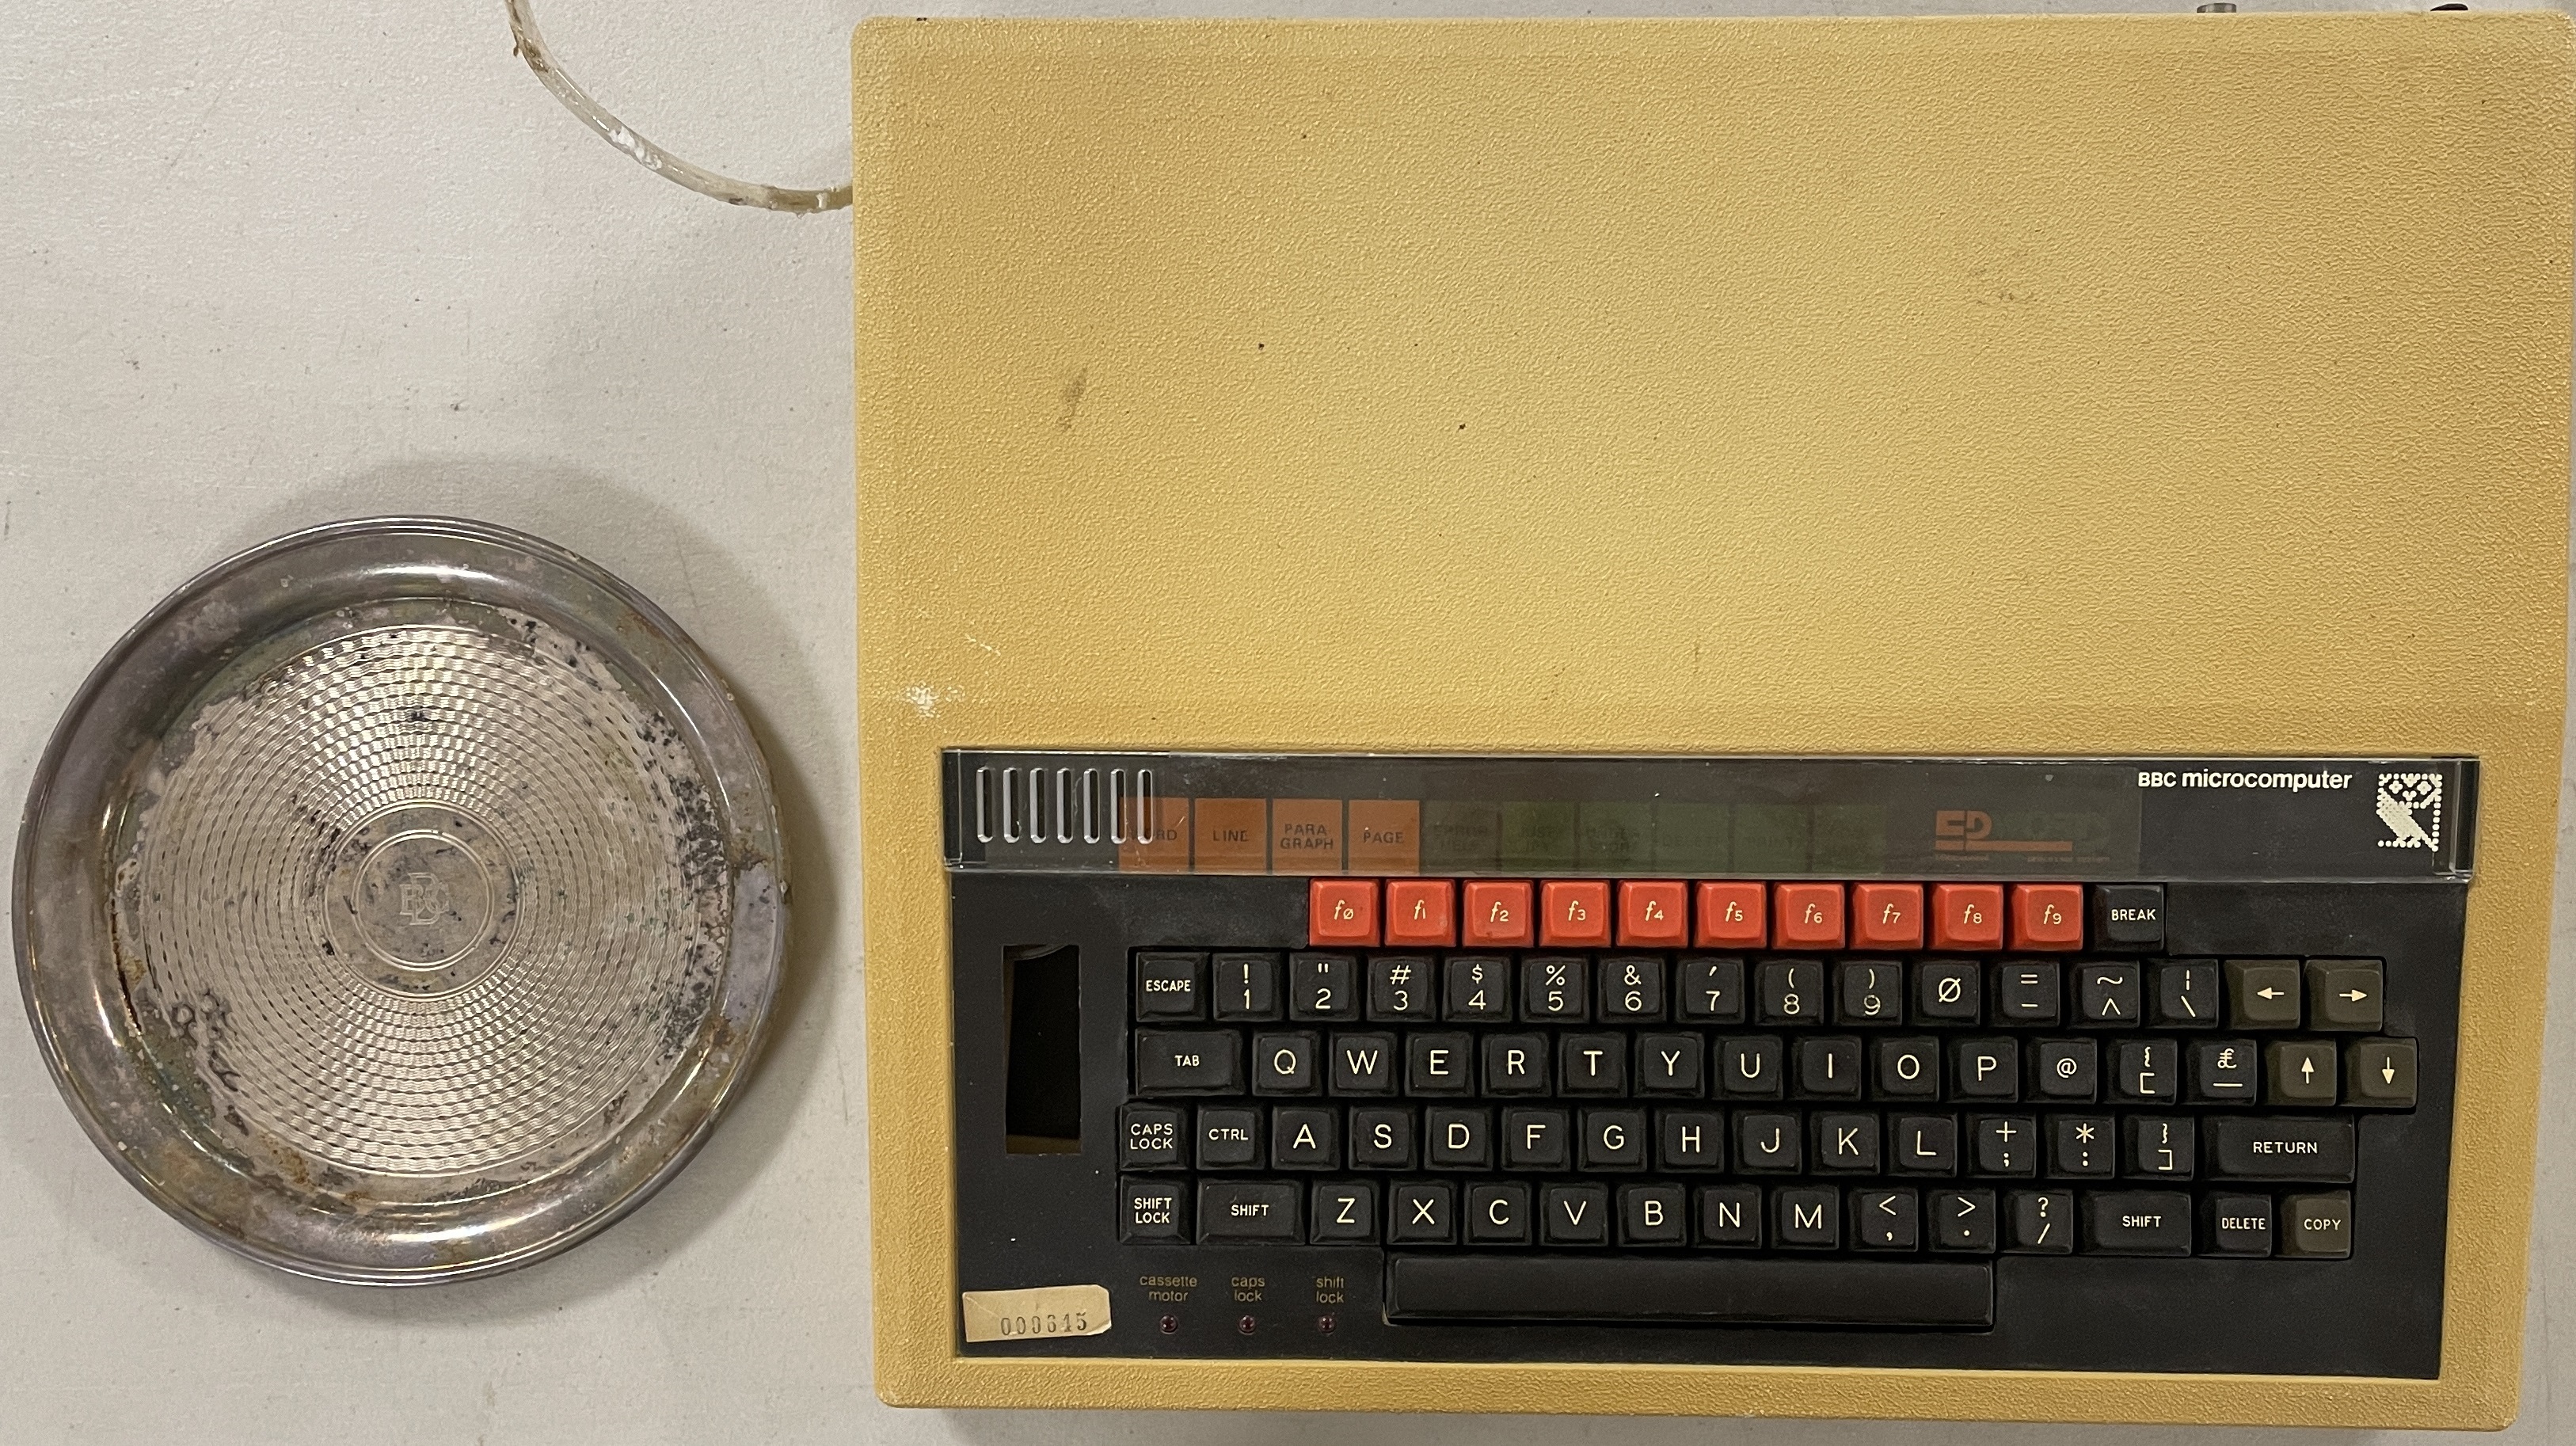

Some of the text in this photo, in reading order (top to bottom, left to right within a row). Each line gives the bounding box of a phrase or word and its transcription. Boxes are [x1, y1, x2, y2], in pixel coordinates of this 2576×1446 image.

[2137, 768, 2353, 793] BBC microcomputer
[1212, 830, 1250, 843] LINE
[1280, 837, 1334, 850] GRAPH
[1363, 831, 1404, 844] PAGE
[1490, 901, 1509, 923] f2
[1568, 900, 1586, 921] f3
[1645, 900, 1664, 922] f4
[1725, 901, 1744, 922] f5
[1804, 903, 1823, 924] f6
[1882, 903, 1901, 924] f7
[1963, 904, 1982, 924] f8
[2043, 904, 2062, 925] f9
[2111, 908, 2156, 921] BREAK
[1243, 964, 1249, 984] !
[1389, 965, 1412, 985] #
[1471, 963, 1483, 984] $
[1545, 965, 1566, 986] %
[1623, 965, 1642, 986] &
[1788, 968, 1794, 989] (
[1868, 968, 1875, 990] )
[1146, 980, 1191, 992] ESCAPE
[1243, 988, 1250, 1010] 1
[1315, 987, 1331, 1010] 2
[1393, 990, 1408, 1011] 3
[1468, 989, 1486, 1010] 4
[1547, 991, 1564, 1012] 5
[1624, 991, 1642, 1011] 6
[1706, 991, 1721, 1011] 7
[1783, 993, 1800, 1015] 8
[1863, 995, 1881, 1015] 9
[1174, 1055, 1200, 1067] TAB
[1273, 1048, 1296, 1075] Q
[1346, 1049, 1378, 1075] W
[1429, 1049, 1449, 1075] E
[1508, 1049, 1525, 1075] R
[1583, 1050, 1604, 1076] T
[1661, 1050, 1680, 1076] Y
[1741, 1052, 1760, 1079] U
[1897, 1054, 1920, 1080] O
[1977, 1056, 1997, 1082] P
[2057, 1057, 2077, 1079] @
[2217, 1048, 2237, 1069] £
[1130, 1123, 1174, 1136] CAPS
[1208, 1128, 1249, 1141] CTRL
[1292, 1124, 1316, 1149] A
[1373, 1124, 1392, 1149] S
[1448, 1124, 1470, 1149] D
[1527, 1124, 1547, 1150] F
[1603, 1124, 1625, 1150] G
[1681, 1125, 1700, 1153] H
[1996, 1121, 2017, 1143] +
[1130, 1137, 1173, 1150] LOCK
[1760, 1128, 1780, 1153] J
[1838, 1127, 1859, 1155] K
[1916, 1130, 1937, 1156] L
[2253, 1141, 2318, 1154] RETURN
[2003, 1152, 2010, 1167] ;
[2082, 1151, 2088, 1166] :
[1133, 1197, 1173, 1210] SHIFT
[1231, 1204, 1269, 1216] SHIFT
[1336, 1197, 1356, 1223] Z
[1412, 1198, 1435, 1225] X
[1489, 1199, 1509, 1225] C
[1563, 1201, 1587, 1226] V
[1645, 1200, 1664, 1226] B
[1878, 1195, 1897, 1216] <
[1957, 1197, 1976, 1217] >
[2038, 1197, 2049, 1218] ?
[1135, 1211, 1170, 1224] LOCK
[1719, 1202, 1741, 1228] N
[1794, 1203, 1822, 1230] M
[2122, 1215, 2162, 1227] SHIFT
[2221, 1217, 2266, 1230] DELETE
[2304, 1218, 2342, 1231] COPY
[1140, 1276, 1197, 1288] cassette
[1231, 1277, 1265, 1293] caps
[1316, 1276, 1344, 1288] shift
[1148, 1290, 1189, 1302] motor
[1234, 1289, 1262, 1303] lock
[1316, 1291, 1344, 1304] lock
